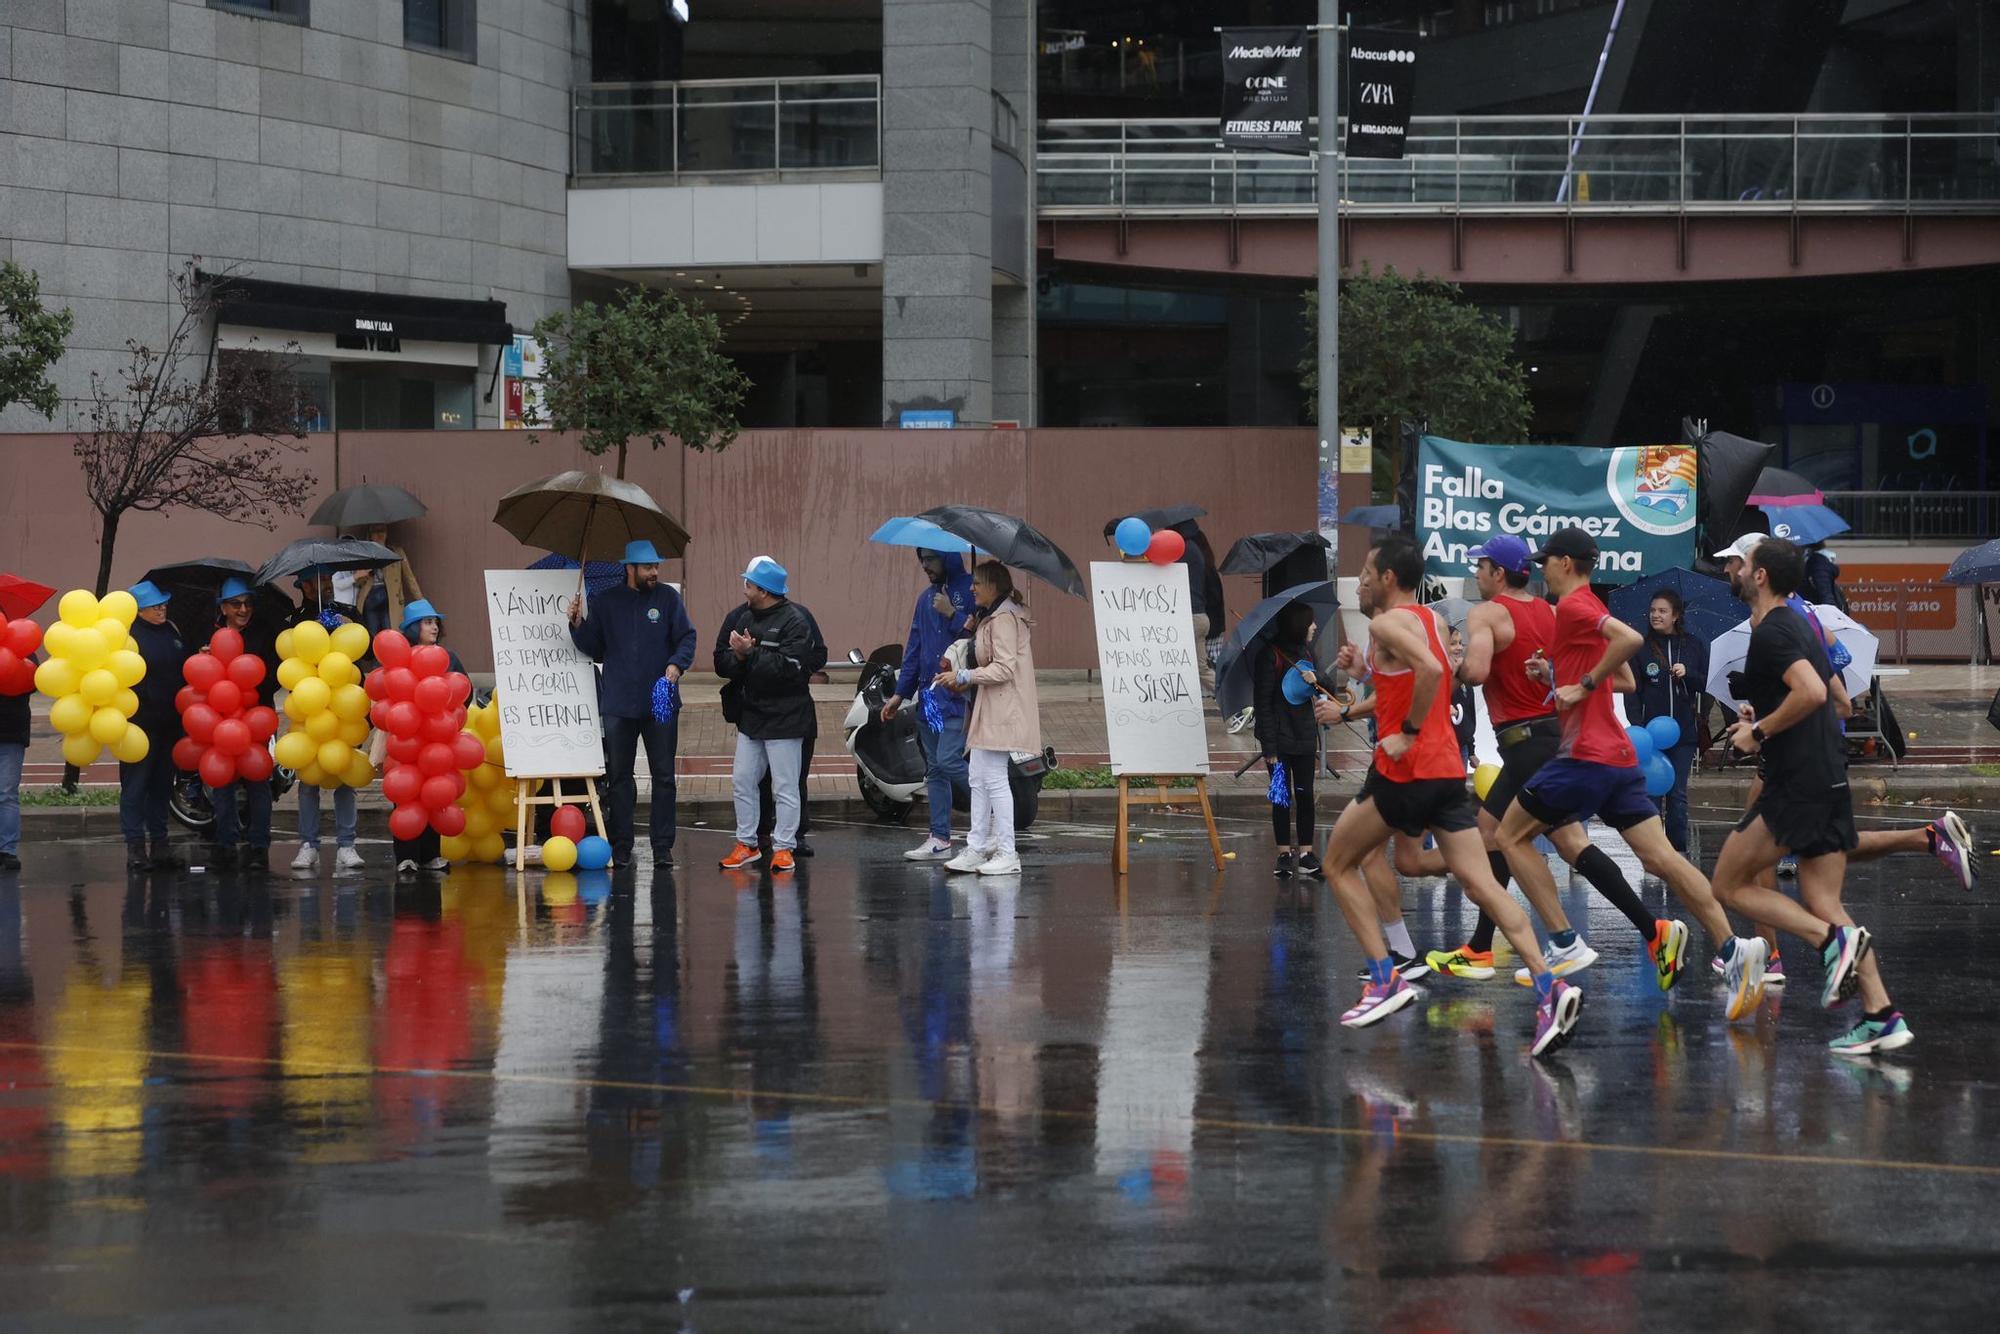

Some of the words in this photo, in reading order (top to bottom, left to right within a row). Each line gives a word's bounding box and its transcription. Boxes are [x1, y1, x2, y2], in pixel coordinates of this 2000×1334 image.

[1245, 76, 1288, 89] OCINE
[1361, 82, 1394, 105] ZARA
[1226, 120, 1271, 132] FITNESS
[1273, 120, 1303, 132] PARK
[1425, 464, 1504, 499] Falla
[1423, 497, 1492, 531] Blas
[1498, 503, 1621, 538] Gámez
[1100, 584, 1178, 614] ¡VAMOS!
[498, 624, 517, 642] EL
[522, 623, 564, 642] DOLOR
[1105, 627, 1131, 643] UN
[1140, 625, 1178, 645] PASO
[497, 650, 513, 666] ES
[1105, 649, 1152, 668] MENOS
[1160, 649, 1192, 667] PARA
[508, 673, 529, 692] LA
[531, 671, 580, 696] GLORIA
[1111, 677, 1130, 694] LA
[1133, 672, 1194, 704] SIESTA
[503, 706, 521, 725] ES
[528, 703, 593, 728] ETERNA
